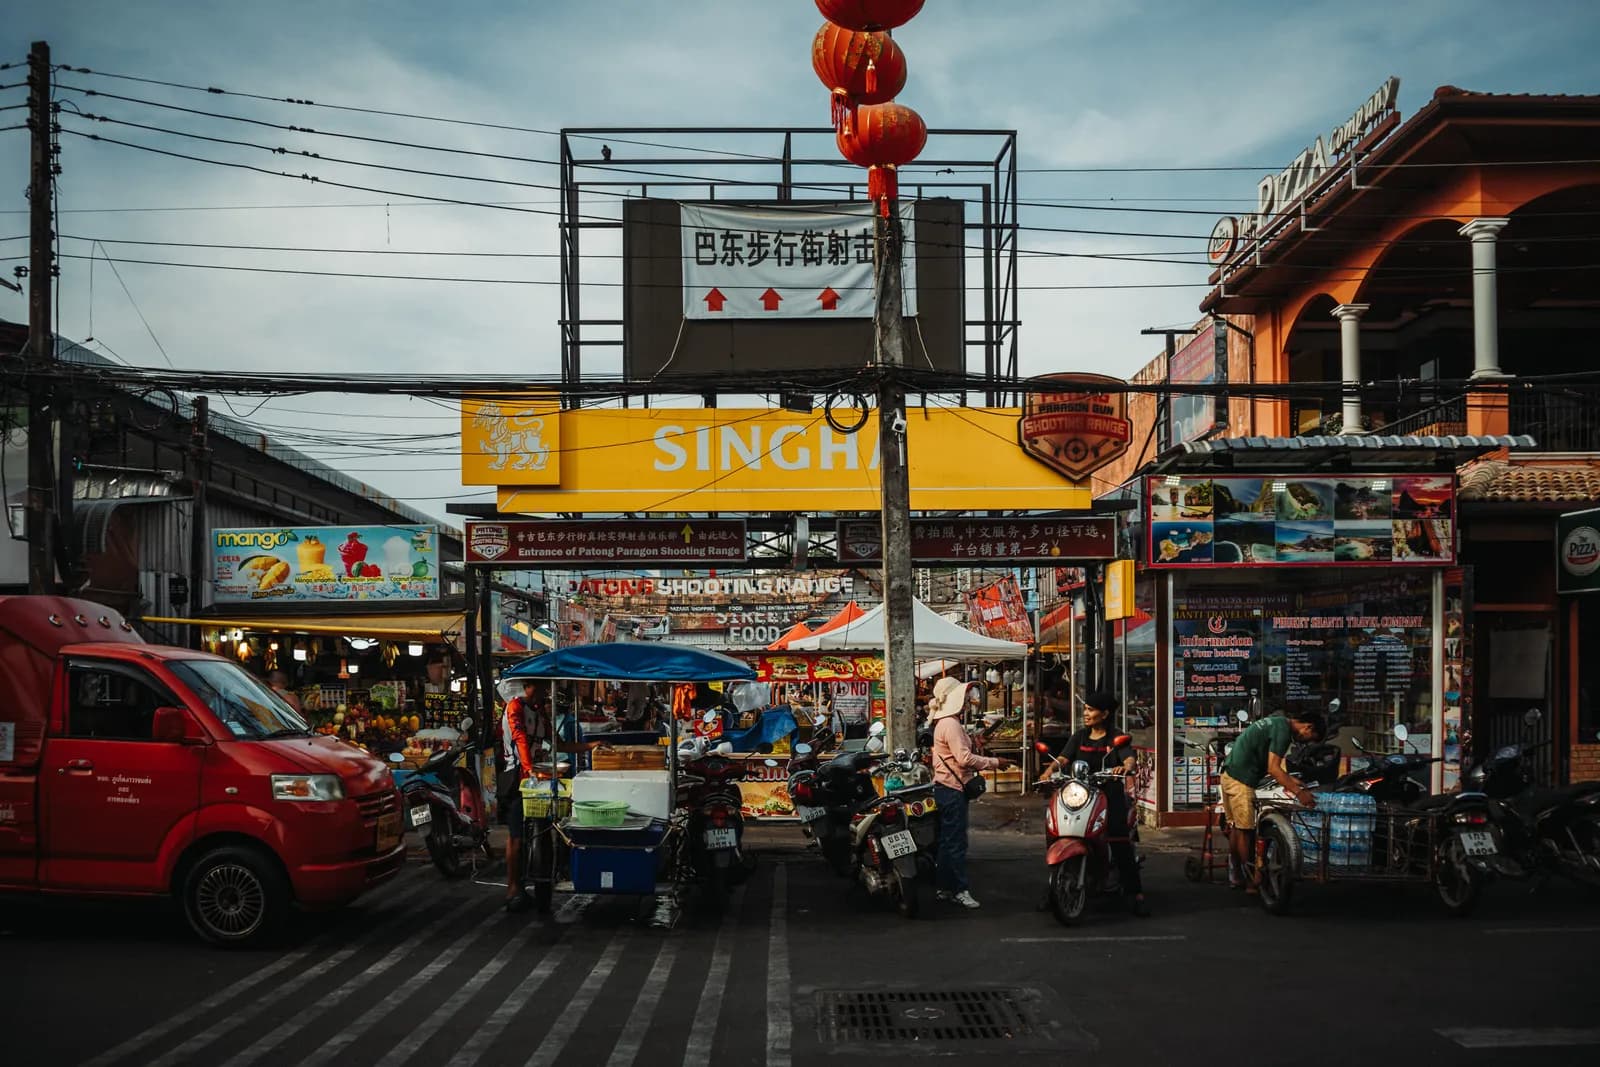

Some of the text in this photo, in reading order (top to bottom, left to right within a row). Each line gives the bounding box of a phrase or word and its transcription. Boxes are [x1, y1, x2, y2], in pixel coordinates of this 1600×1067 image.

[1256, 134, 1331, 234] PIZZA
[695, 229, 875, 267] 巴东步行街射击
[1092, 404, 1114, 415] GUN
[1024, 416, 1127, 434] SHOOTING RANGE
[653, 425, 880, 473] SINGH
[217, 531, 289, 550] mango
[698, 530, 738, 541] 由此进入
[518, 546, 741, 558] Entrance of Patong Paragon Shooting Range
[951, 543, 1049, 557] 平台销量第一名
[1569, 542, 1597, 556] PIZZA
[657, 578, 772, 594] SHOOTING
[776, 577, 853, 593] RANGE
[1272, 615, 1424, 629] PHUKET SHANTI TRAVEL COMPANY
[730, 626, 780, 643] FOOD
[1179, 635, 1254, 647] Information
[1183, 648, 1250, 659] & Tour booking
[1192, 662, 1239, 672] WELCOME
[1191, 673, 1242, 685] Open Daily
[851, 681, 867, 696] NO
[893, 846, 912, 858] 227
